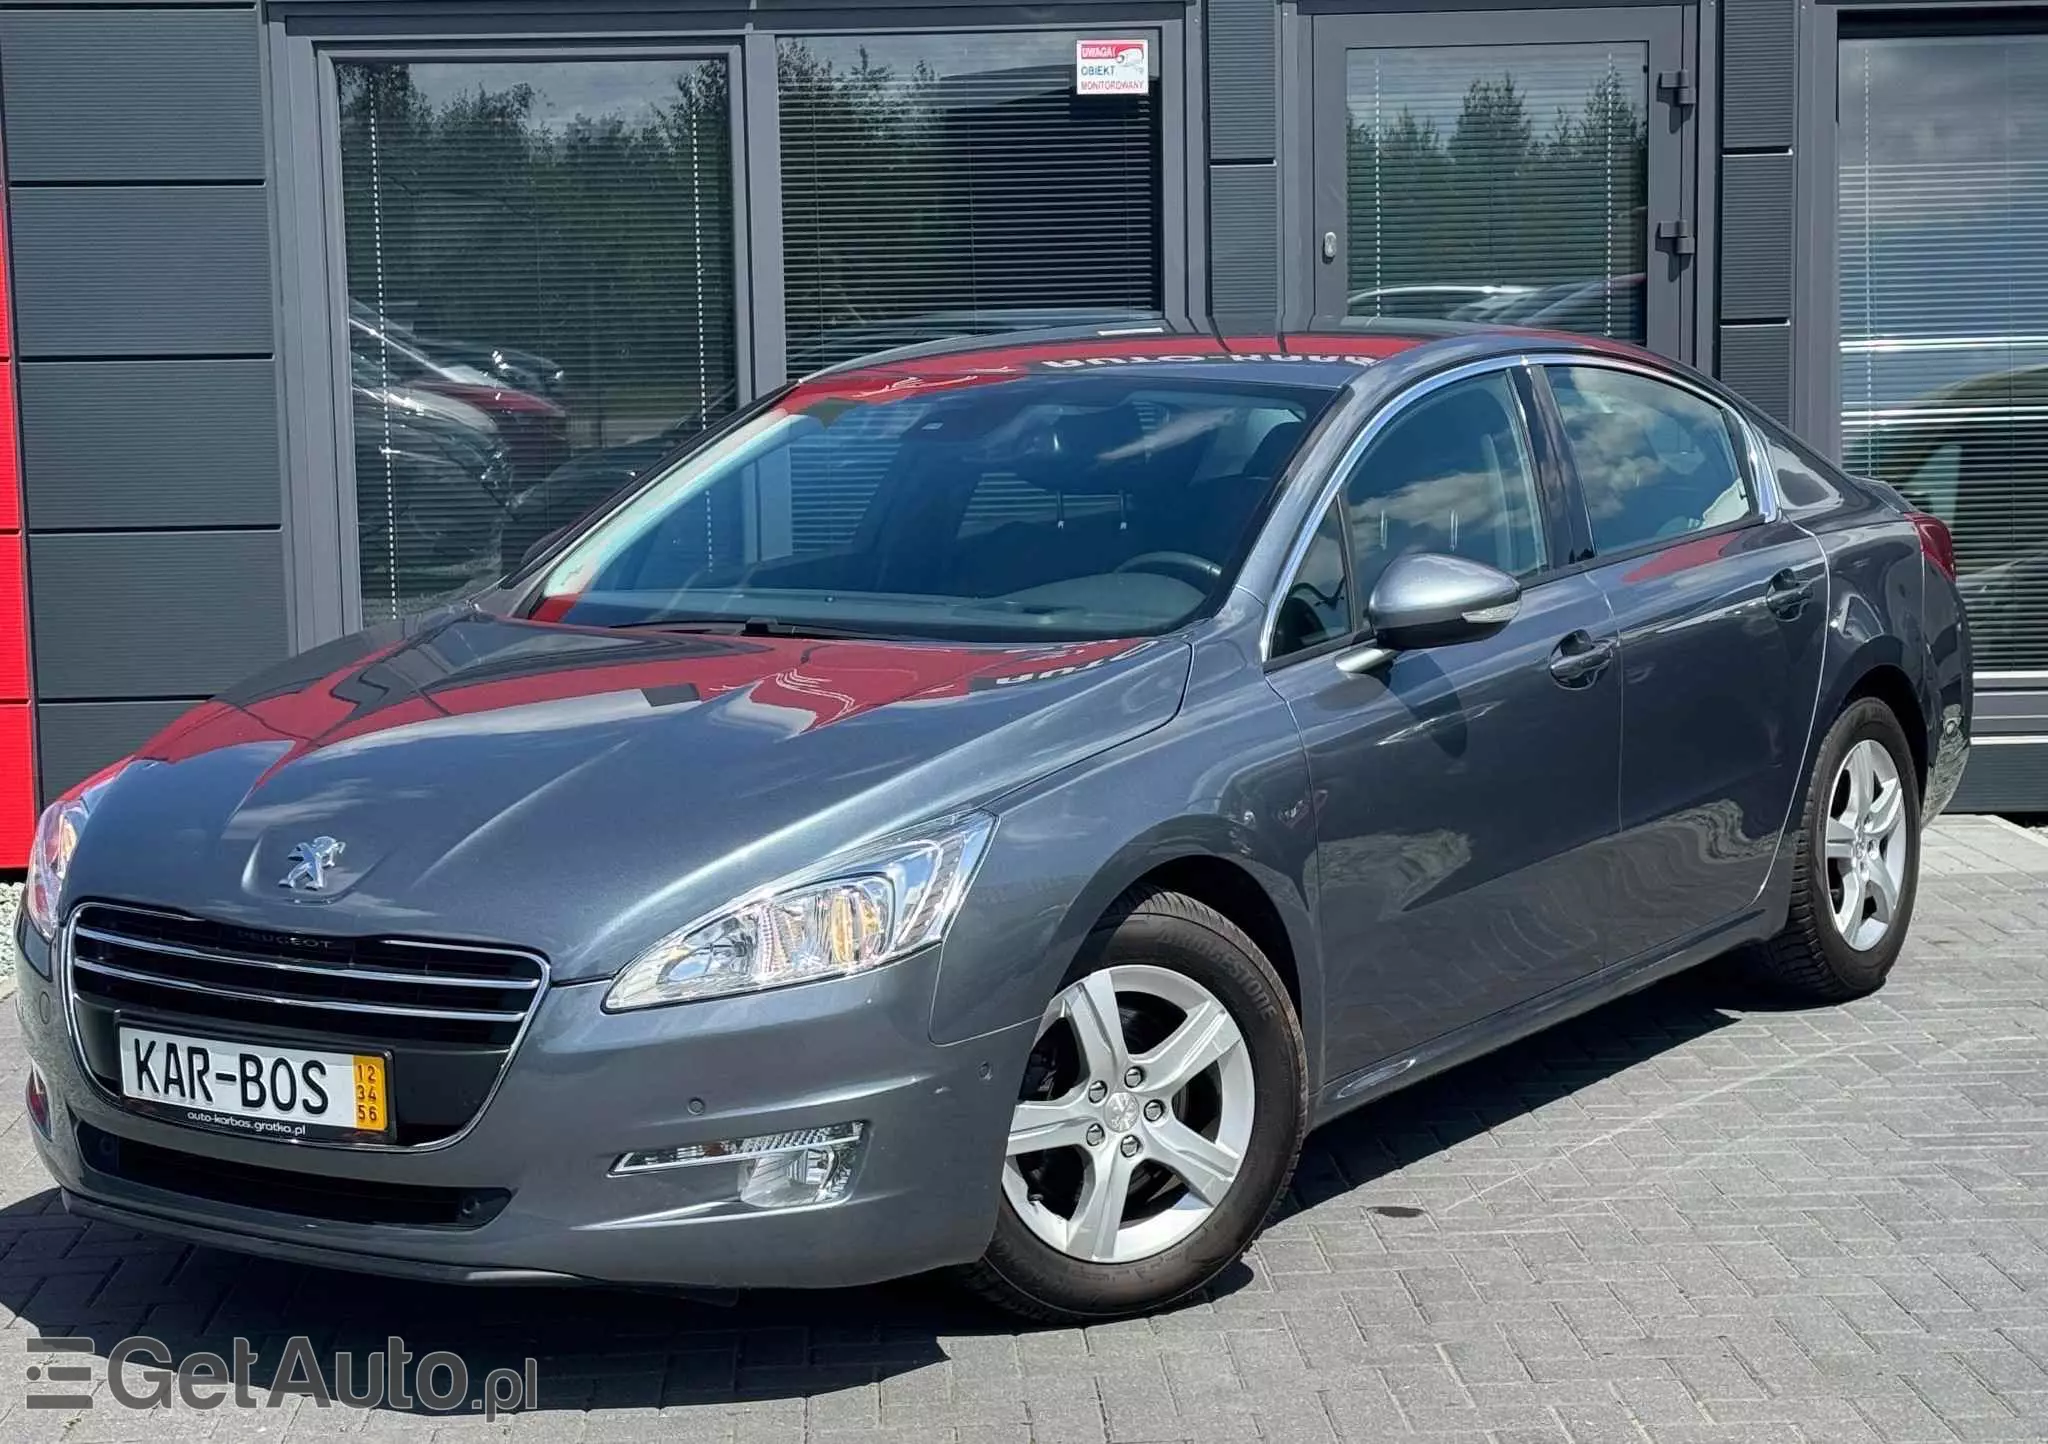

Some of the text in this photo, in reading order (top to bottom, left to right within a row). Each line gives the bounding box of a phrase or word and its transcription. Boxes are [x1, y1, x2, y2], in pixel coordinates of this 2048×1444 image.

[1081, 66, 1115, 76] OBIEKT
[1081, 80, 1144, 90] MONITOROWANY
[134, 1038, 329, 1115] KAR-BOS
[358, 1064, 376, 1083] 12
[357, 1084, 377, 1101] 34
[358, 1104, 378, 1121] 56
[187, 1111, 306, 1136] auto-karbos.gratka.pl
